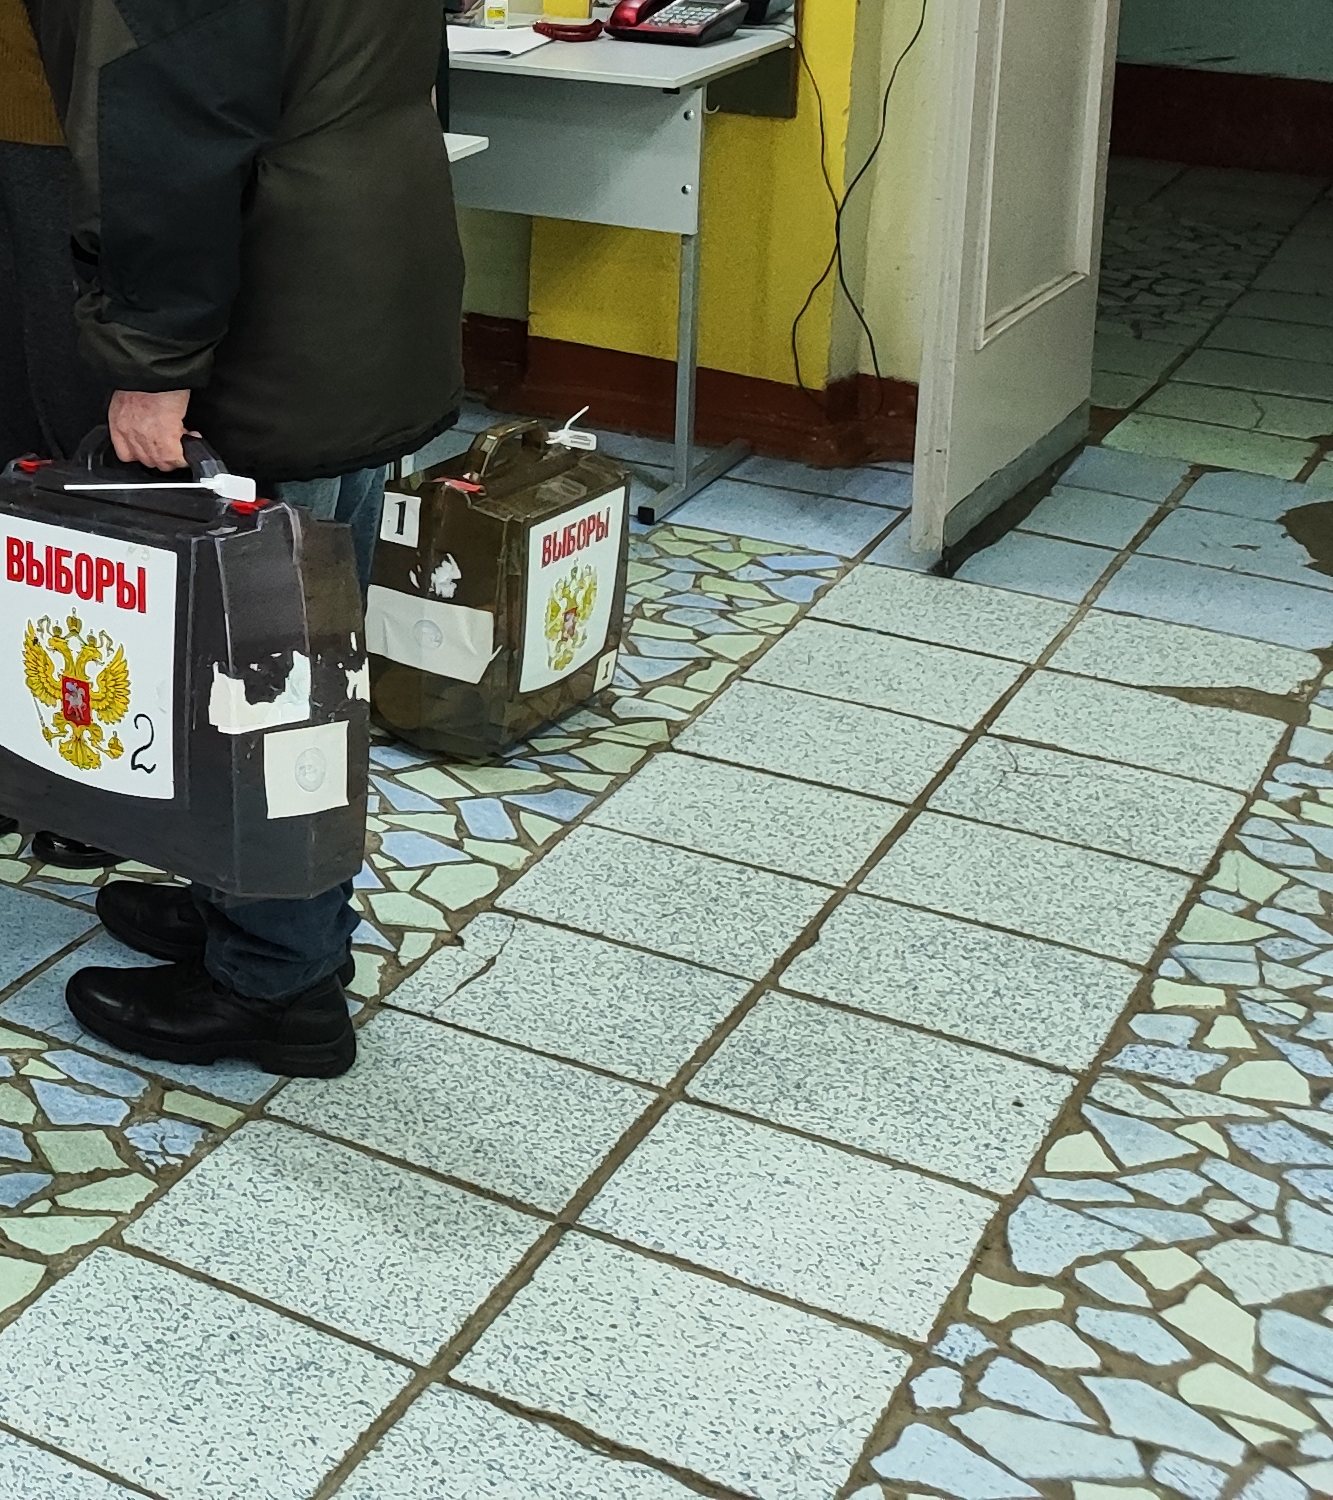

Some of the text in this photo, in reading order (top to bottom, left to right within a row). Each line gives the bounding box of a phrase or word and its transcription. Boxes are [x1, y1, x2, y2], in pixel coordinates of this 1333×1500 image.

[394, 500, 408, 537] 1
[540, 506, 612, 569] ВЫБОРЫ
[6, 534, 148, 615] ВЫБОРЫ
[601, 660, 611, 681] 1
[129, 712, 158, 776] 2
